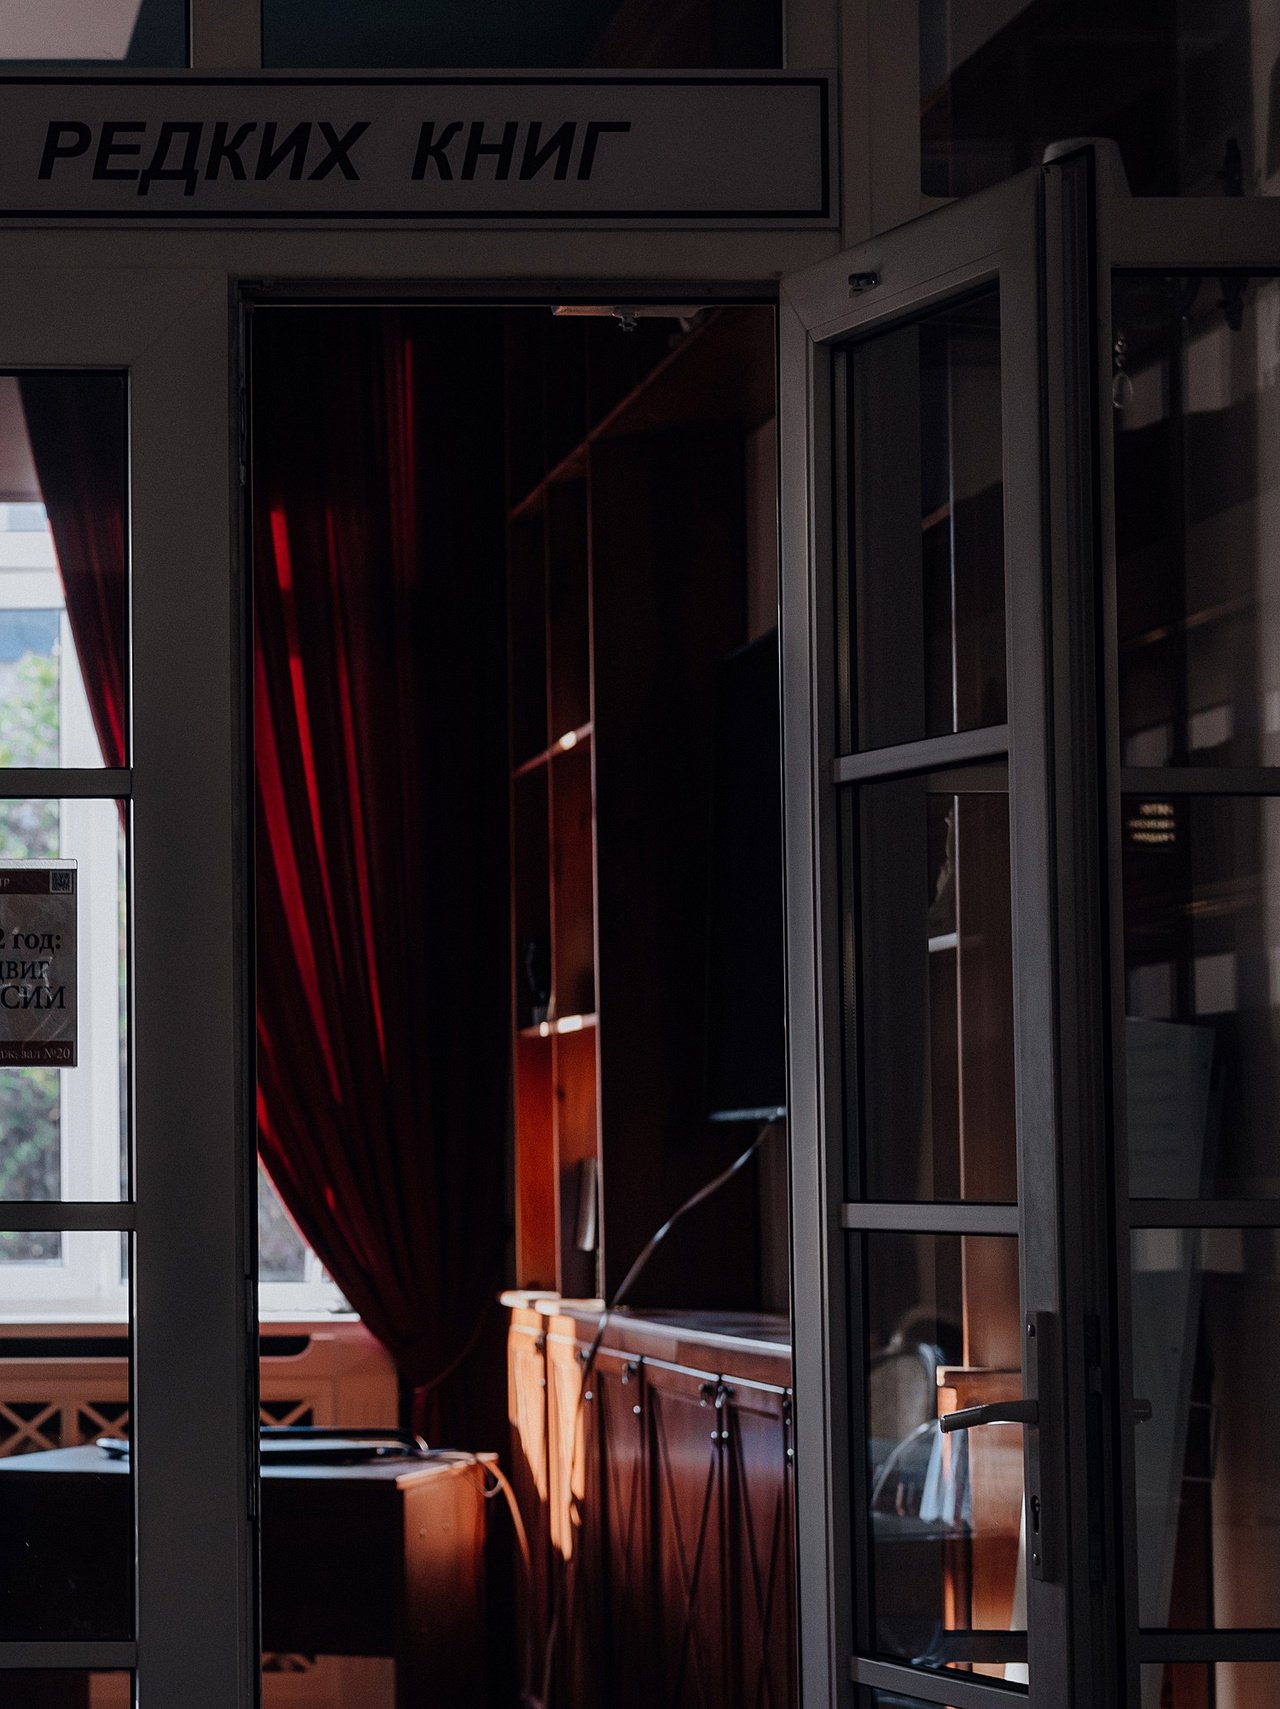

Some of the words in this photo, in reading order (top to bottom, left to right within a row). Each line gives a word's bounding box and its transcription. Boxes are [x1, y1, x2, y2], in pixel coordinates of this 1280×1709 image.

[37, 119, 372, 197] РЕДКИХ
[412, 120, 632, 182] КНИГ
[12, 933, 62, 954] год:
[43, 1048, 71, 1060] №20
